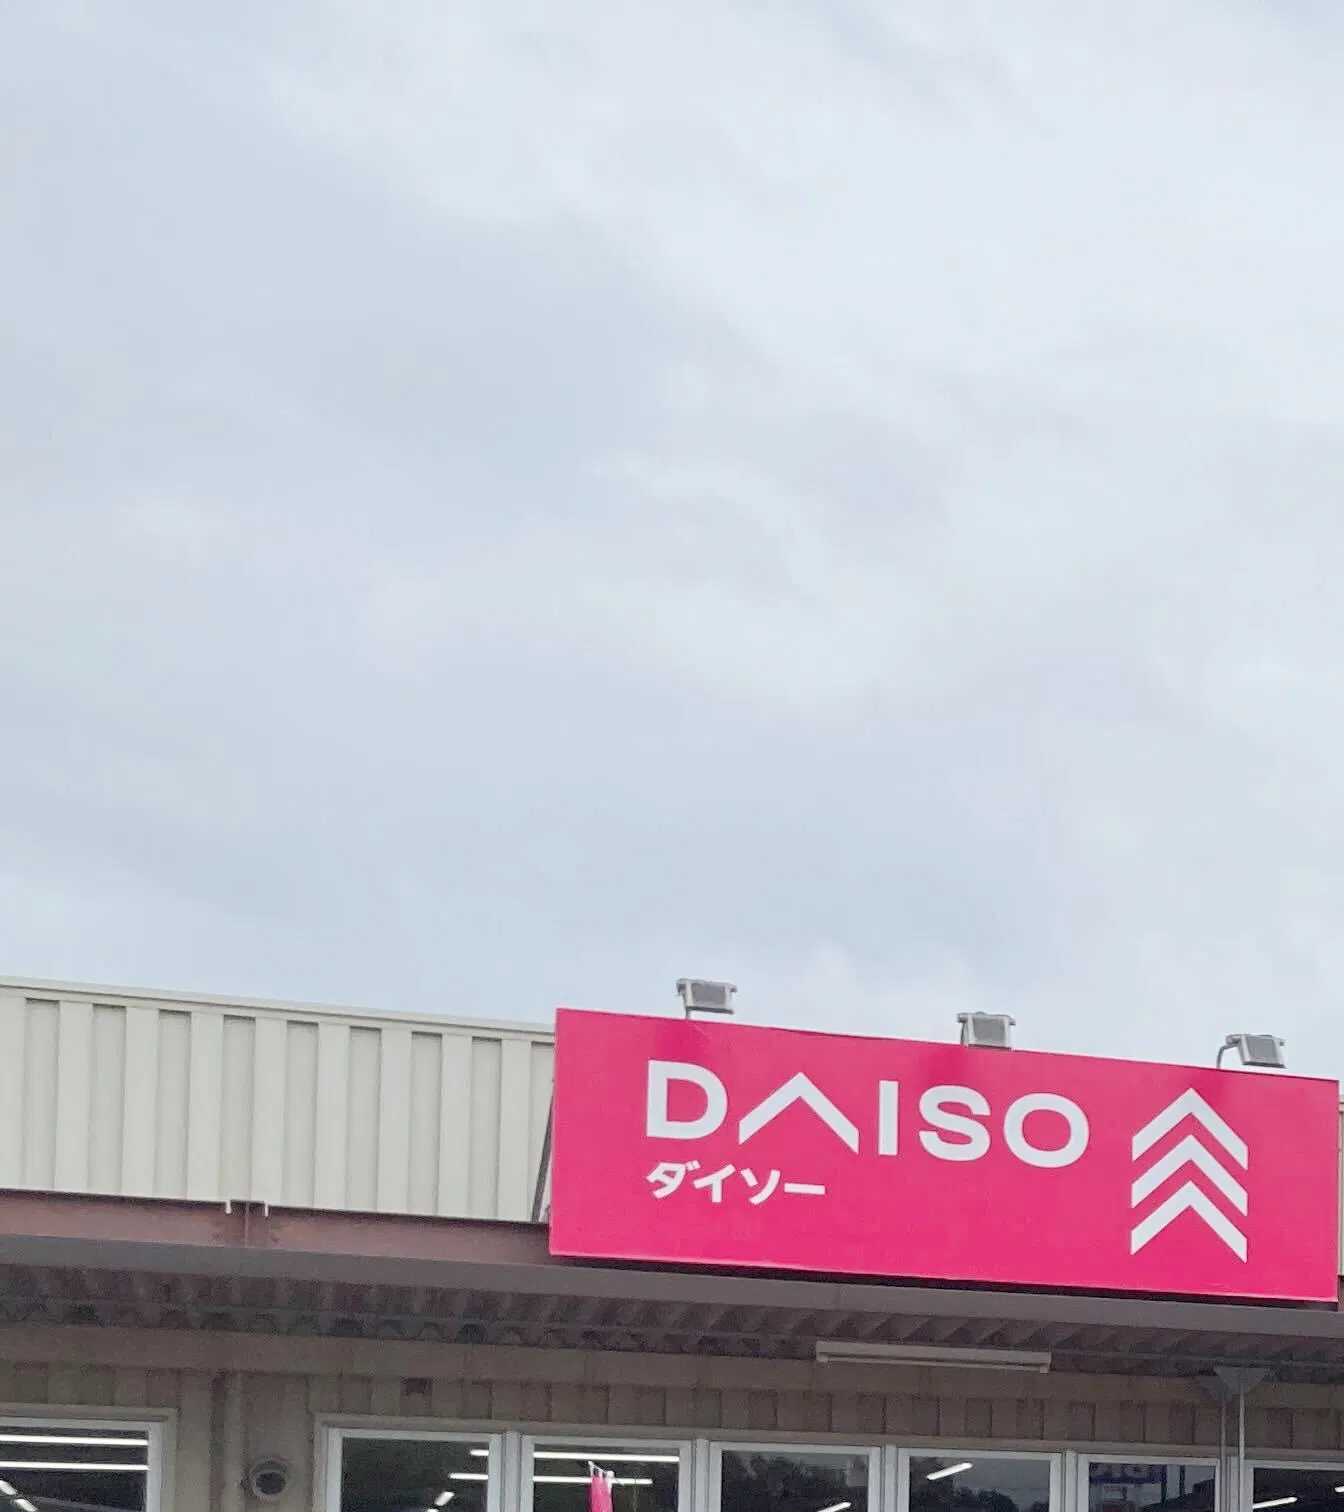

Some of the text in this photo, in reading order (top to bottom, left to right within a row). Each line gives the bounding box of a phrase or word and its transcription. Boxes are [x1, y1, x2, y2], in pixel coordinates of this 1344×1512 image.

[646, 1059, 1090, 1169] DAISO
[645, 1160, 826, 1206] ダイソー
